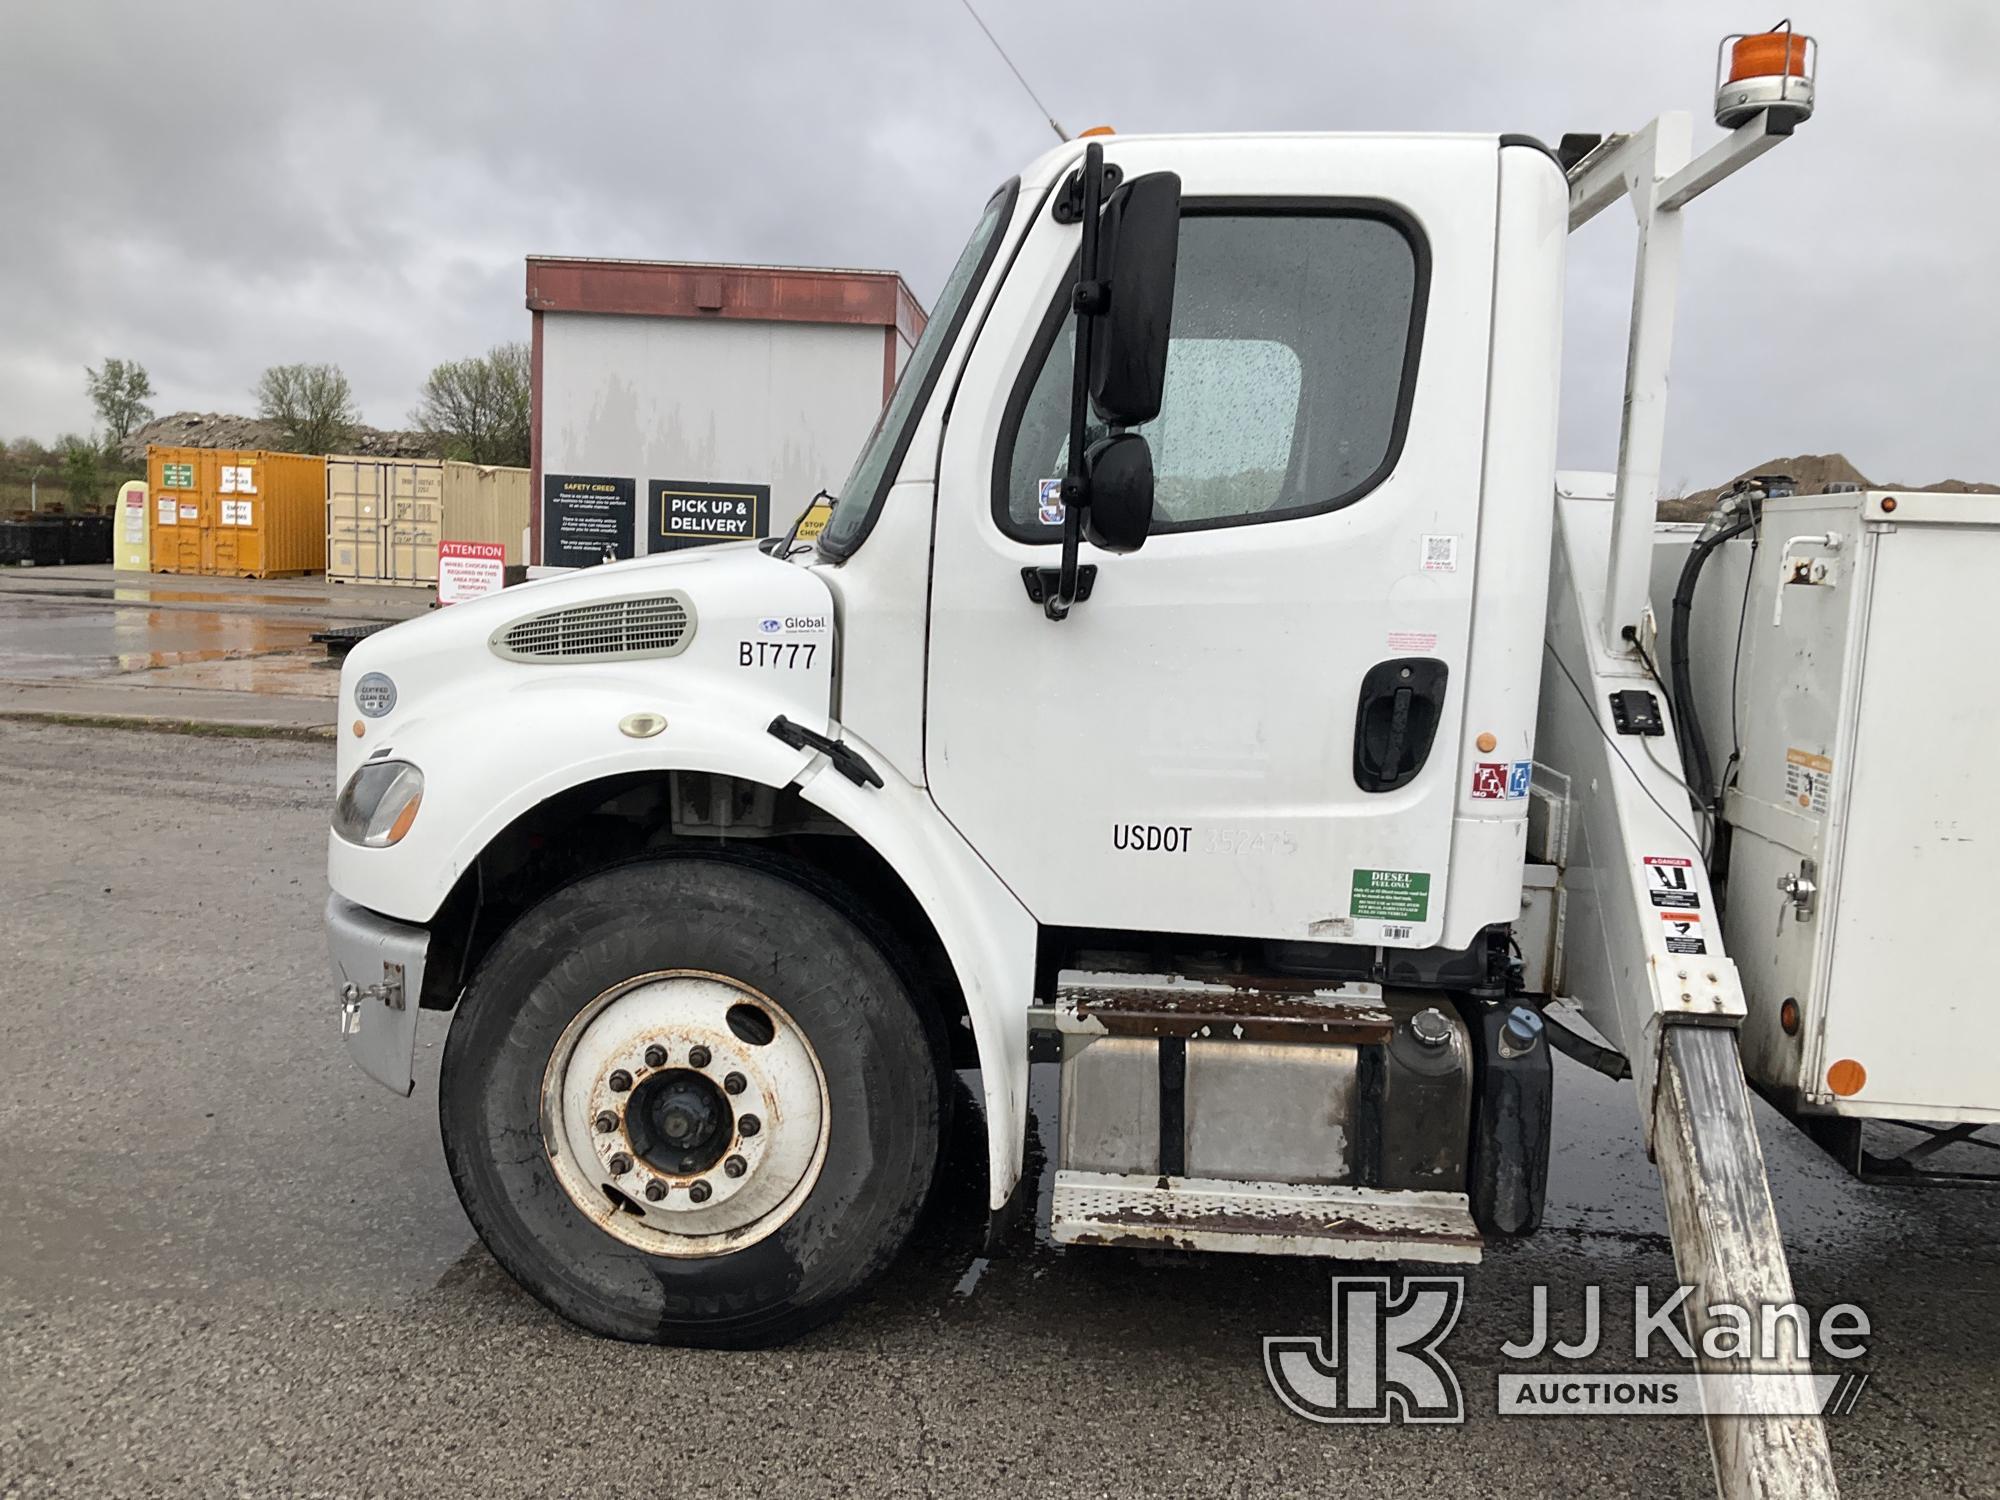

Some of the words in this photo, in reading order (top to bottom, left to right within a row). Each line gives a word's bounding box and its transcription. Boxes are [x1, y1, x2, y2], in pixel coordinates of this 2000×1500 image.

[671, 499, 707, 513] PICK
[712, 501, 732, 514] UP
[736, 502, 747, 515] &
[671, 517, 747, 532] DELIVERY
[442, 544, 502, 556] ATTENTION
[785, 617, 824, 628] Global
[740, 642, 816, 669] BT777
[1114, 824, 1192, 852] USDOT
[1372, 872, 1412, 882] DIESEL
